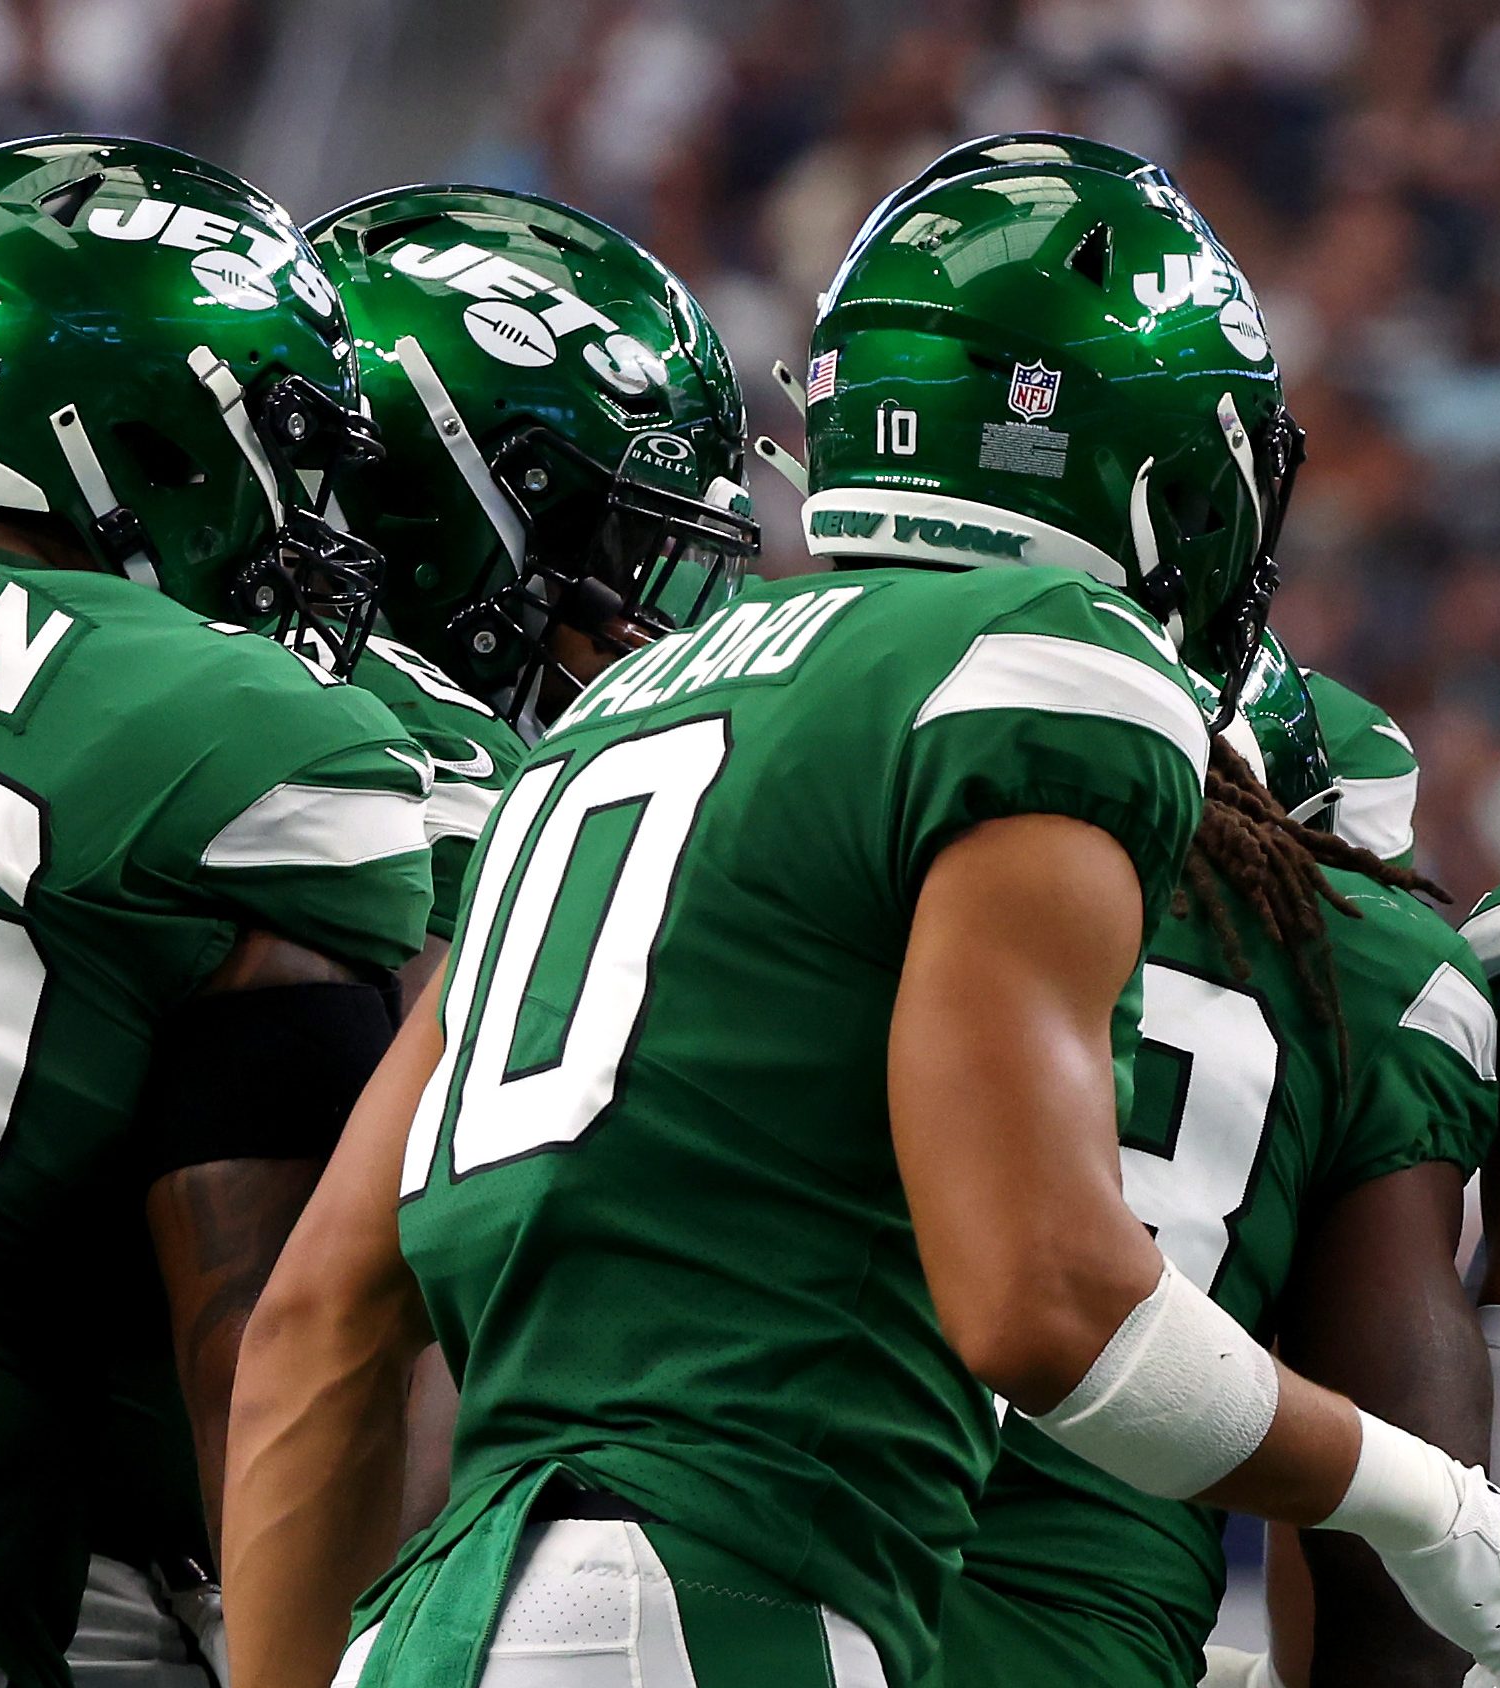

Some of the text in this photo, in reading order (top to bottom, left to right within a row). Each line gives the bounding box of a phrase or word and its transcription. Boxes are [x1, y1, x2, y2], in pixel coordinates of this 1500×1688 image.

[88, 198, 337, 318] JETS
[1133, 246, 1258, 312] JET
[391, 242, 669, 395] JETS
[1015, 384, 1049, 412] NFL
[875, 407, 918, 456] 10
[631, 448, 694, 476] OAKLEY
[809, 510, 1032, 558] NEW YORK
[398, 711, 733, 1204] 10
